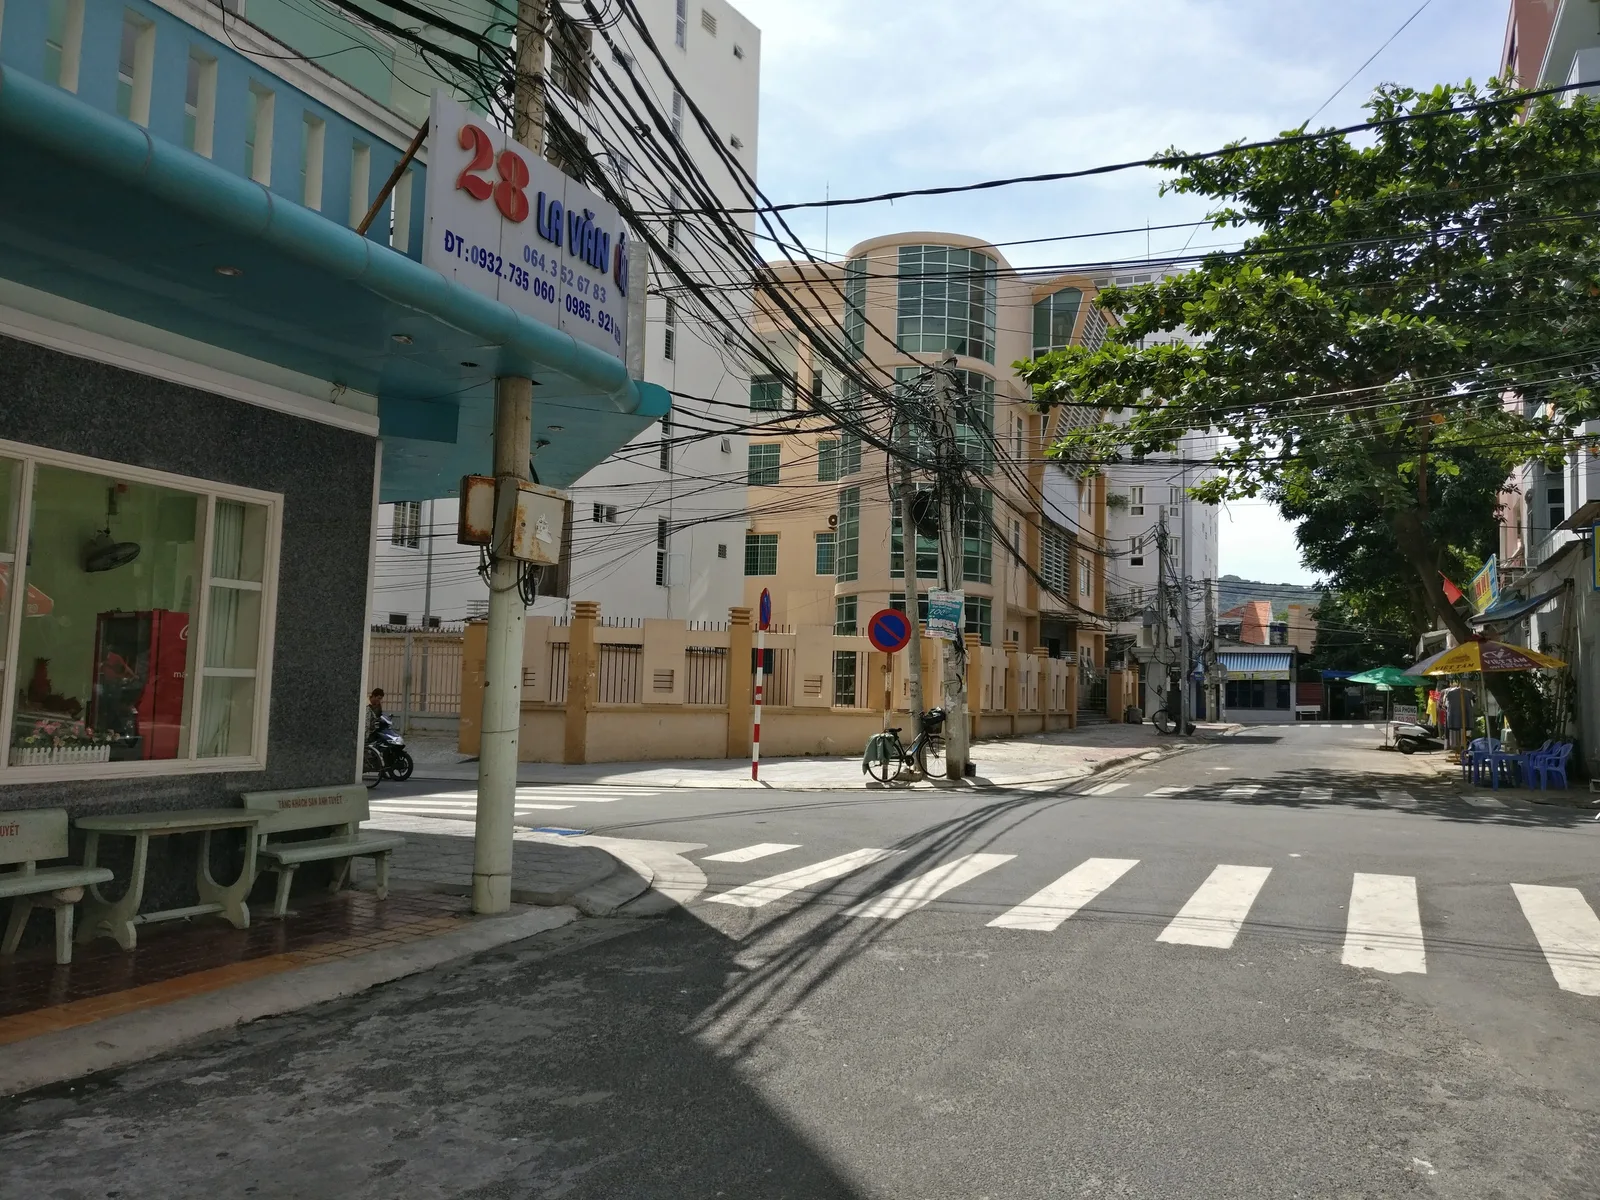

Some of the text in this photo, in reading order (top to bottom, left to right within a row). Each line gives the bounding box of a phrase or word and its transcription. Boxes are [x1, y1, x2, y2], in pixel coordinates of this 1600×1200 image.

[456, 124, 530, 223] 28
[536, 191, 564, 247] LA
[567, 208, 611, 275] VĂN
[533, 276, 556, 304] 060
[577, 274, 591, 296] 67
[592, 283, 607, 304] 83
